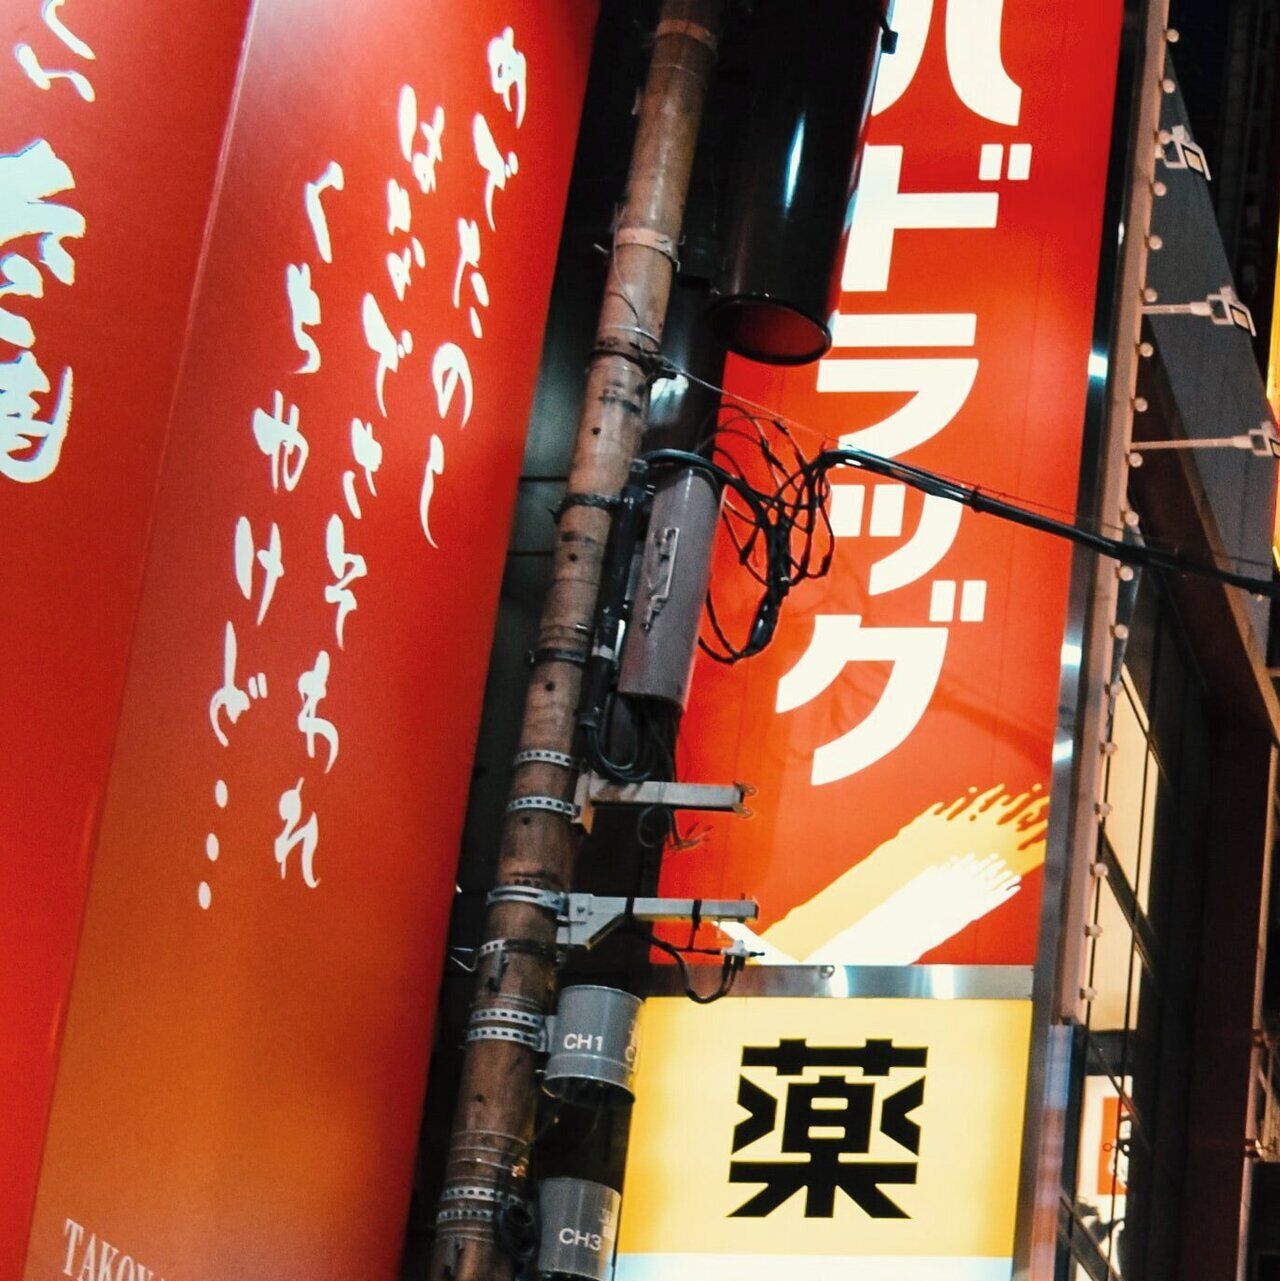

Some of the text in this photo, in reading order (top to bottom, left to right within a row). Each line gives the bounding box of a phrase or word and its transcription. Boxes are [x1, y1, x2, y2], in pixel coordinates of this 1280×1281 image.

[563, 1032, 604, 1052] CH1
[726, 1039, 930, 1219] 薬
[558, 1228, 602, 1251] CH3
